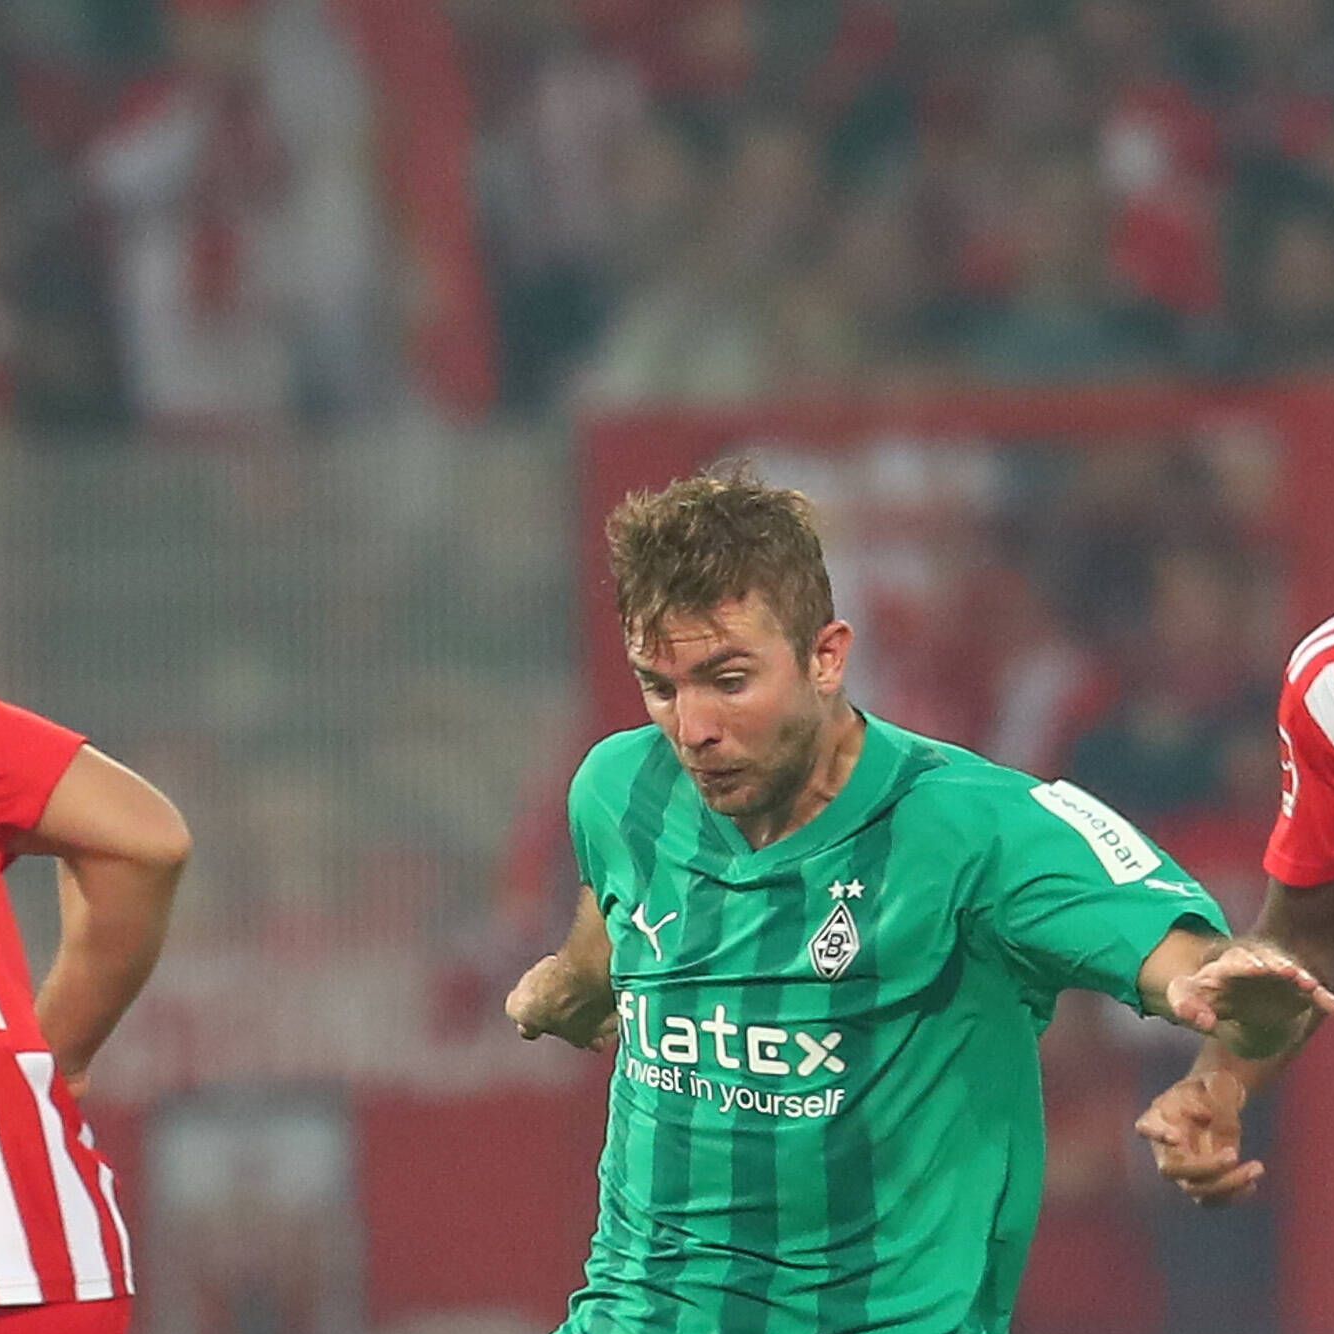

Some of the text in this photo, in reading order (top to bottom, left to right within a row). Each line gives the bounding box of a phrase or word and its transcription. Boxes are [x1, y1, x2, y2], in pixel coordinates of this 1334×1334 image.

[625, 1057, 845, 1118] nvest in yourself
